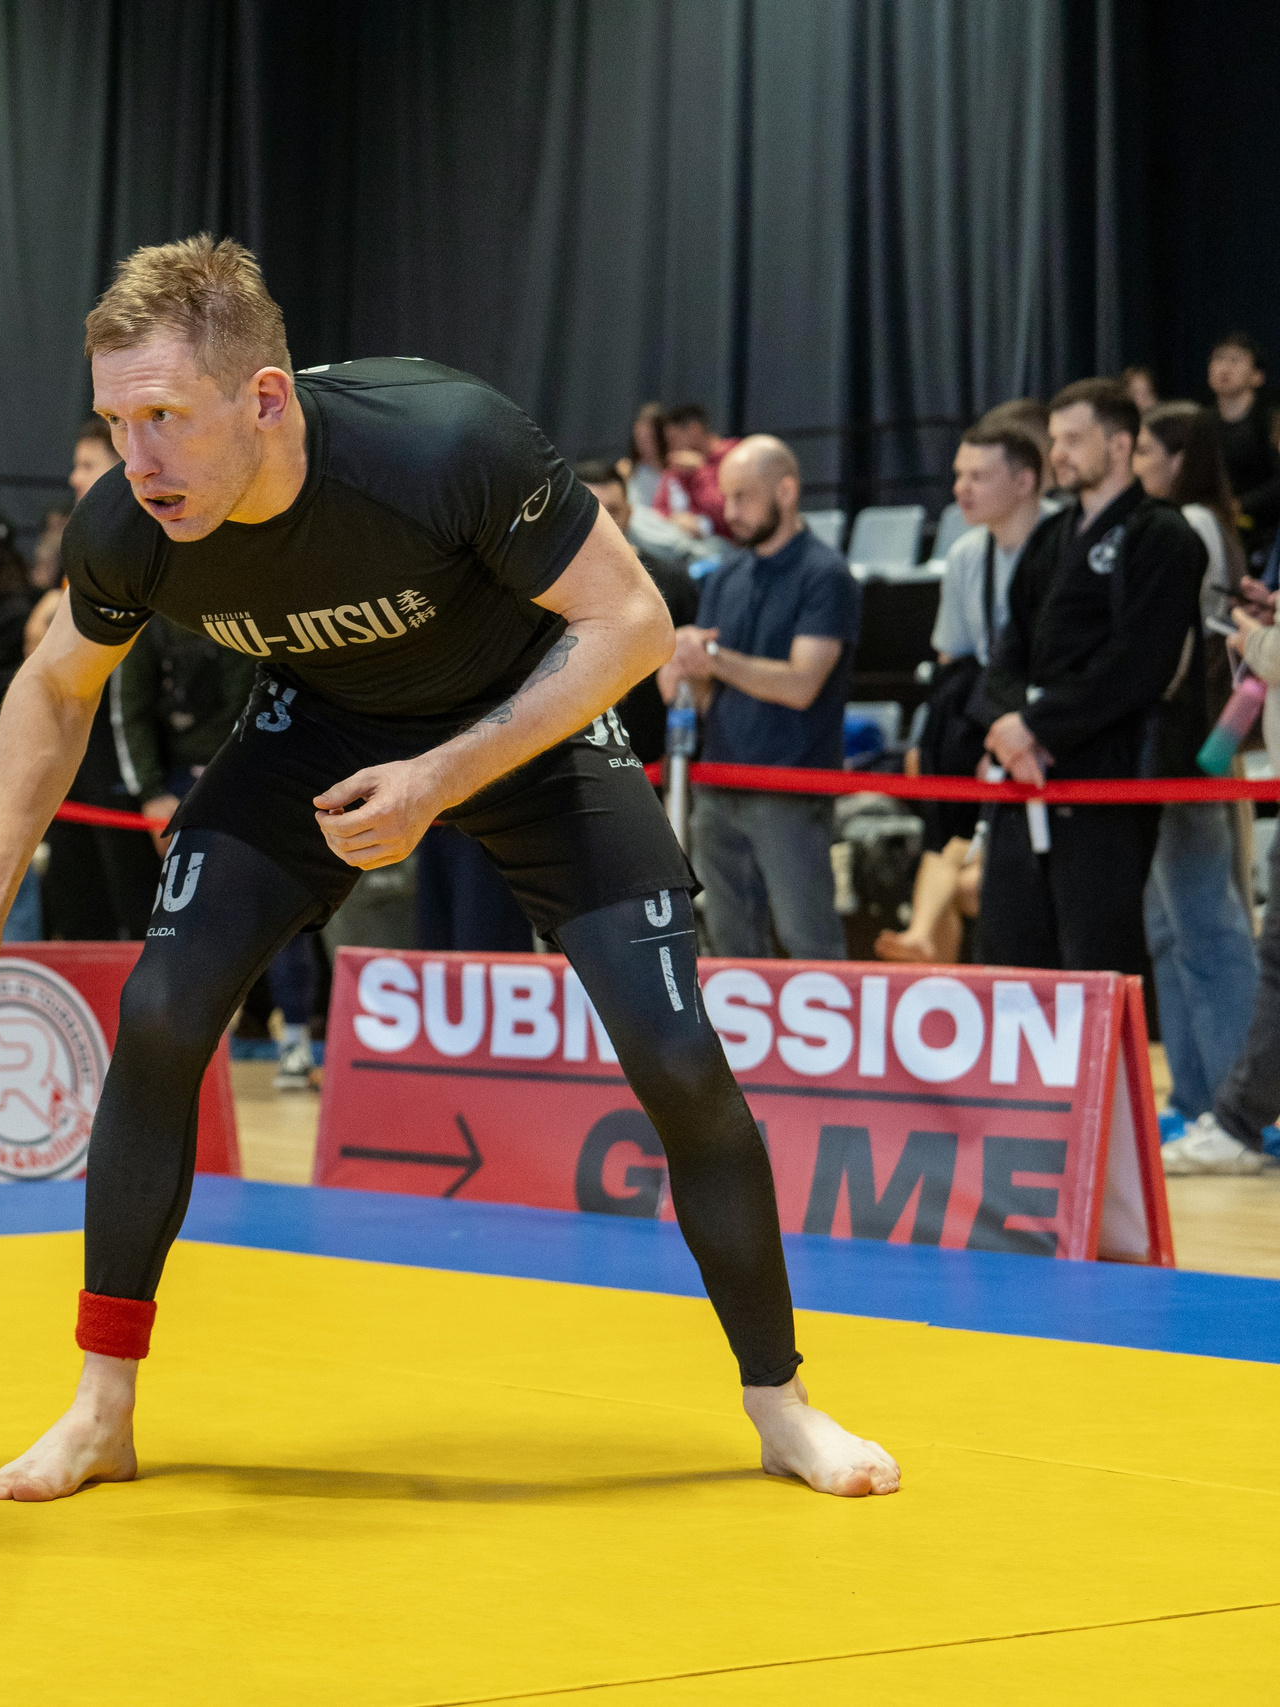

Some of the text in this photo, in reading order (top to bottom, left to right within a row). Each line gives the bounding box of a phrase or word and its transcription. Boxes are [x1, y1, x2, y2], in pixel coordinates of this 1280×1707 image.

[201, 611, 251, 623] BRAZILIAN
[352, 957, 1083, 1088] SUBSSION
[575, 1107, 1068, 1258] GME
